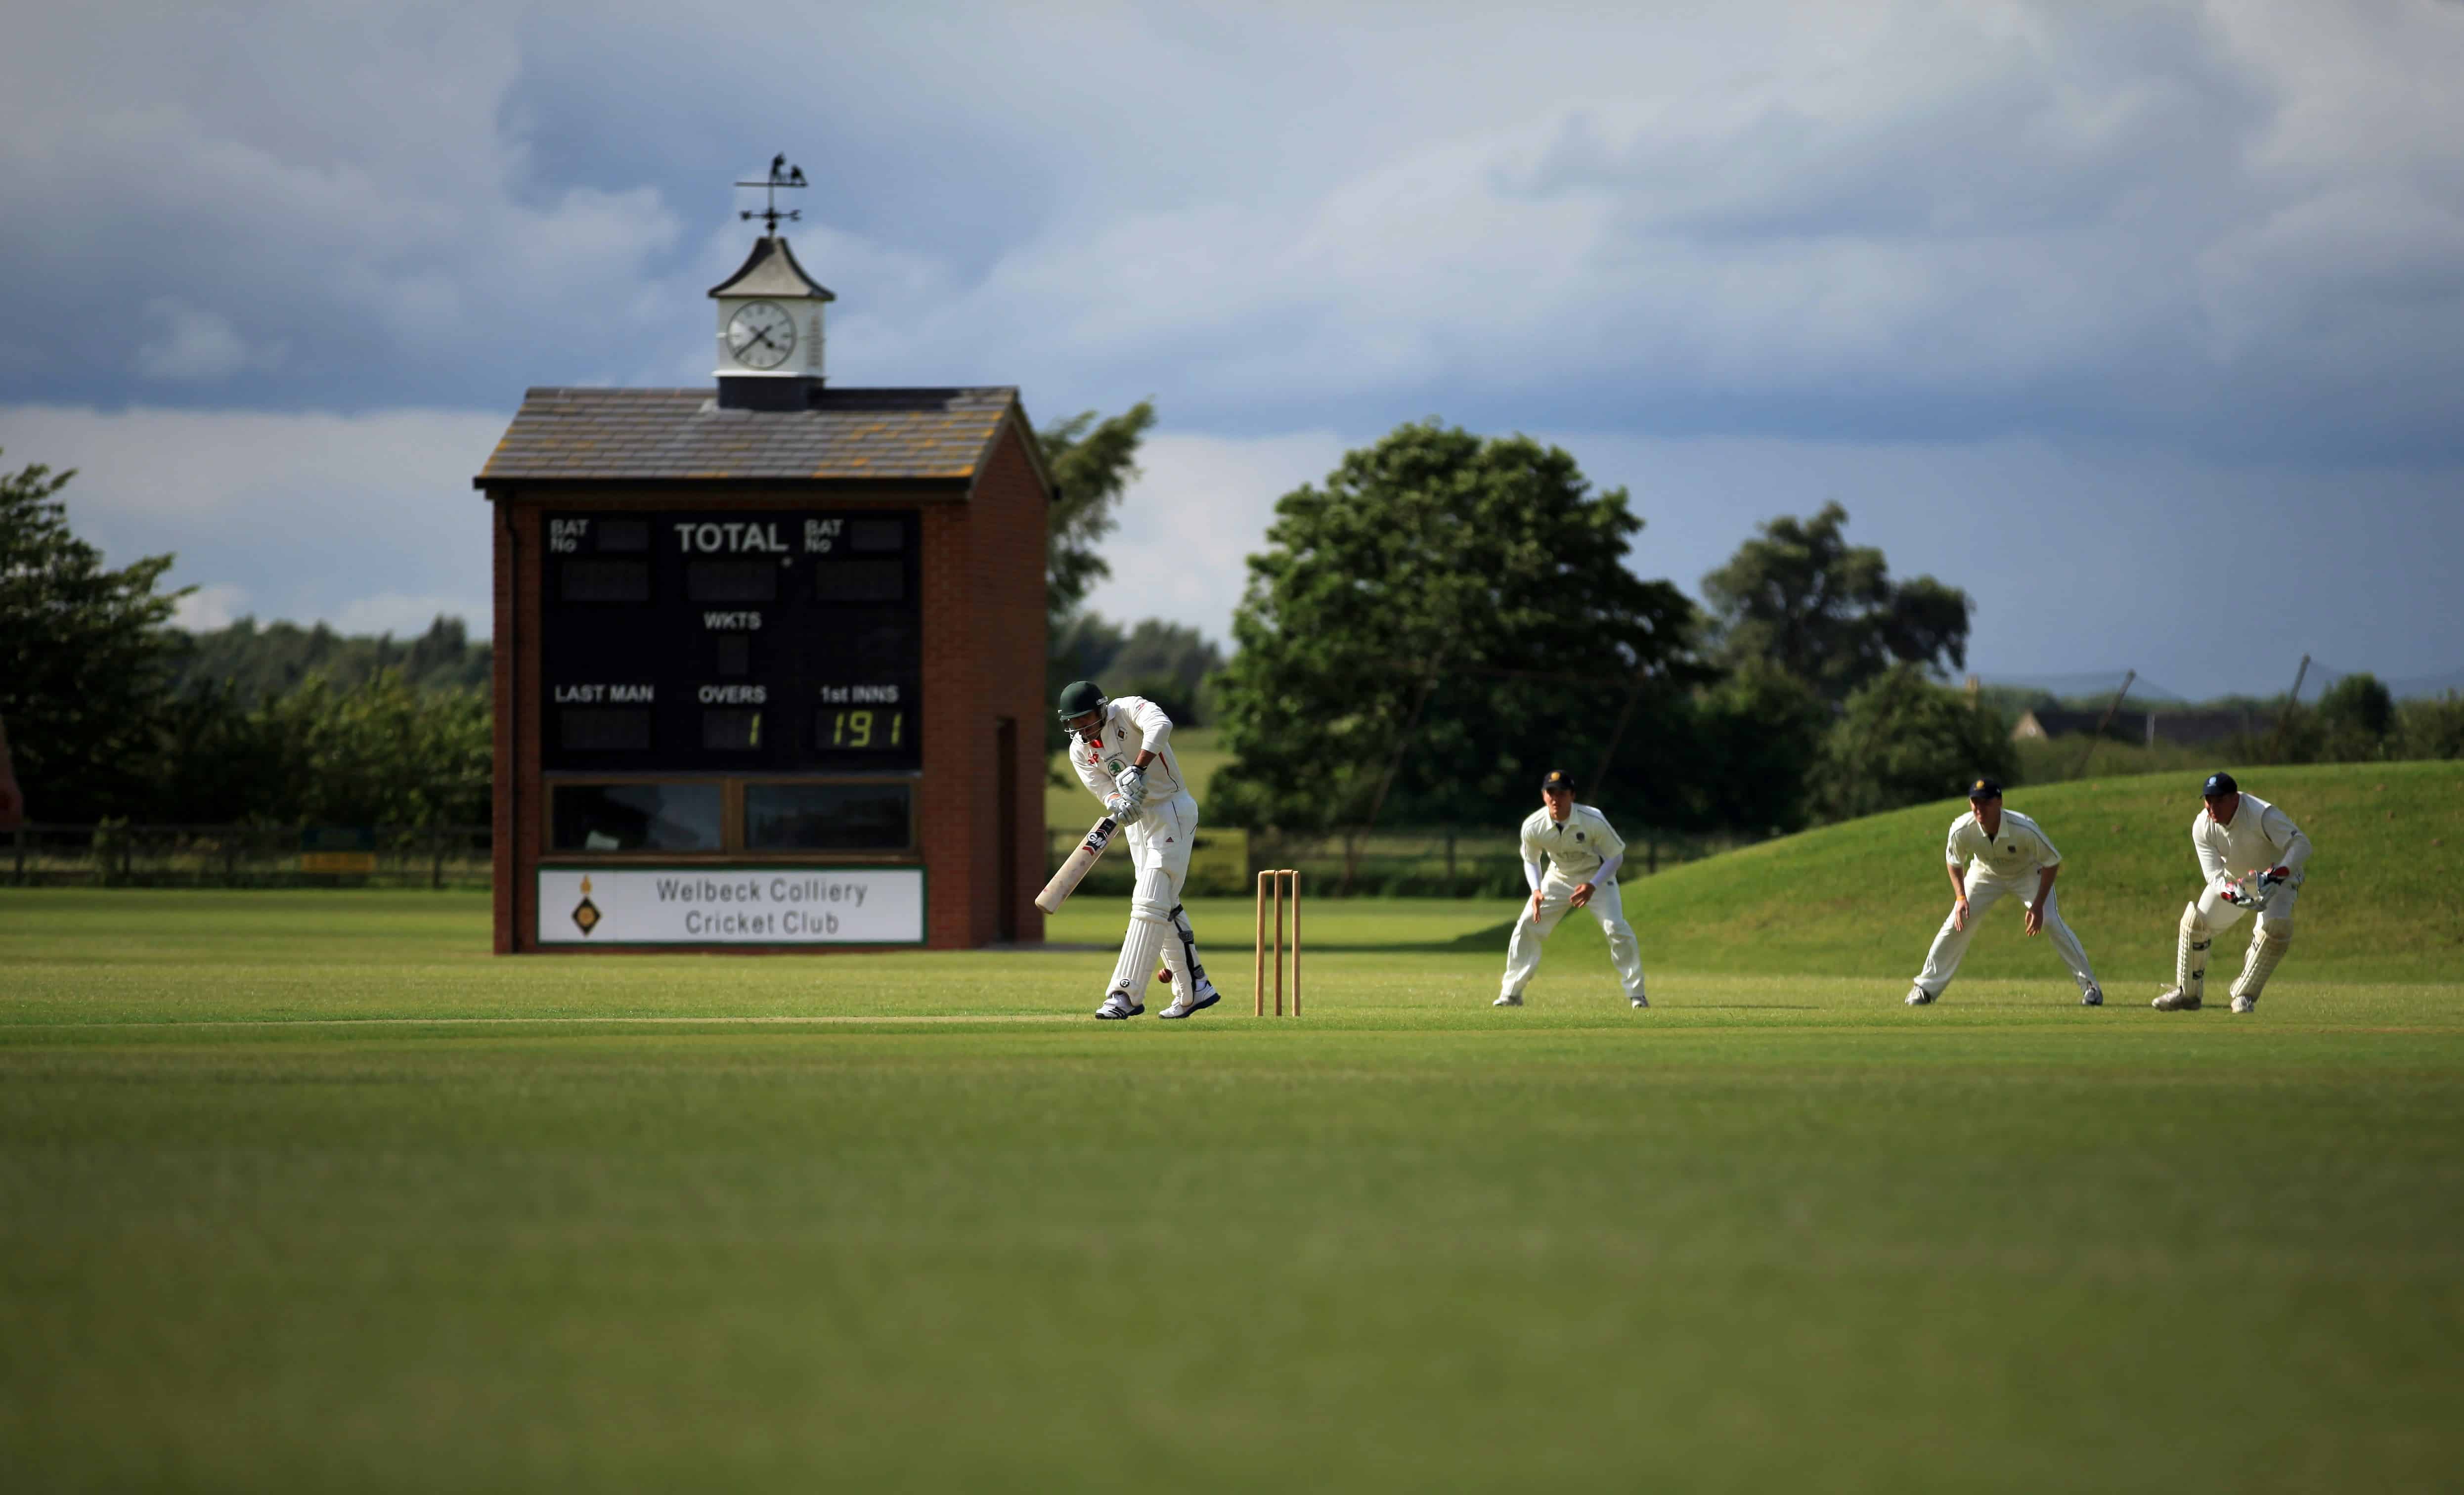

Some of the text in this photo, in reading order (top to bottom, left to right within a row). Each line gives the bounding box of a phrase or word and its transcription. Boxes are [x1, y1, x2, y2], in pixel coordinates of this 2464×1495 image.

[551, 519, 589, 536] BAT
[804, 519, 843, 536] BAT
[550, 538, 576, 553] No
[675, 523, 789, 552] TOTAL
[804, 538, 831, 553] No
[704, 612, 762, 629] WKTS
[555, 685, 654, 702] LAST MAN
[698, 685, 766, 704] OVERS
[821, 685, 900, 703] 1st INNS
[749, 713, 760, 746] 1
[833, 711, 902, 747] 191
[1087, 833, 1107, 849] GM
[656, 878, 867, 907] Welbeck Colliery
[685, 911, 838, 934] Cricket Club
